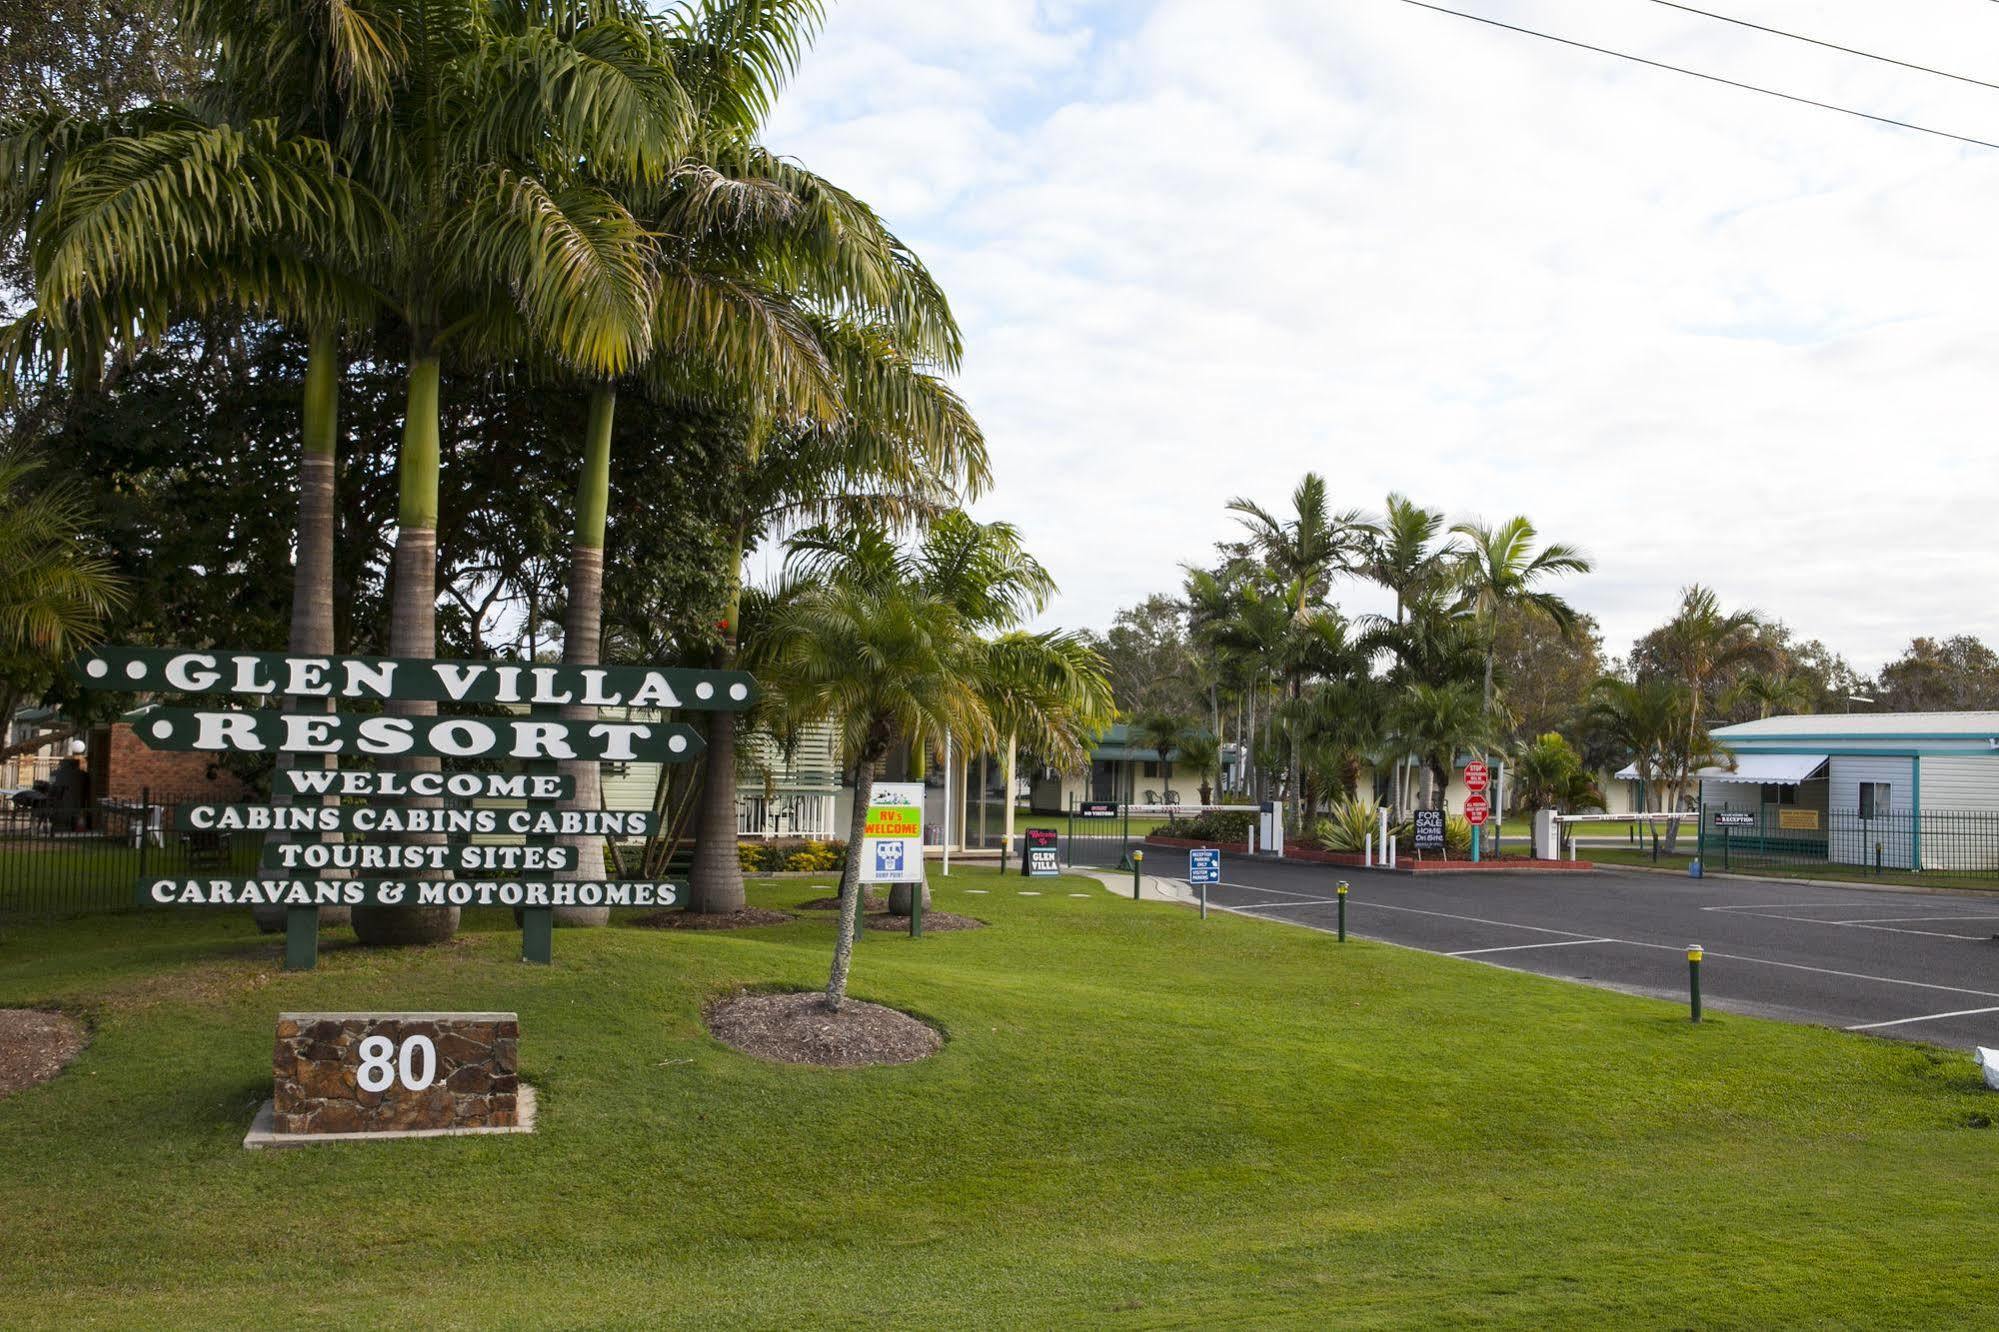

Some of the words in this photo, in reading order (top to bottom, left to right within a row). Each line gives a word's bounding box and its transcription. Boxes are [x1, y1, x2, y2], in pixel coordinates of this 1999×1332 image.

[166, 653, 399, 698] GLEN
[431, 663, 683, 708] VILLA
[192, 712, 652, 760] RESORT
[286, 770, 563, 798] WELCOME
[190, 806, 340, 831] CABINS
[352, 808, 496, 833] CABINS
[508, 810, 647, 835] CABINS
[865, 824, 917, 834] WELCOME
[880, 811, 902, 821] RV's
[1416, 819, 1442, 827] SALE
[278, 844, 450, 869] TOURIST
[461, 846, 567, 870] SITES
[1031, 862, 1057, 870] VILLA
[1032, 853, 1055, 861] GLEN
[151, 879, 365, 904] CARAVANS
[376, 880, 406, 904] &
[417, 882, 676, 906] MOTORHOMES
[356, 1035, 437, 1093] 80
